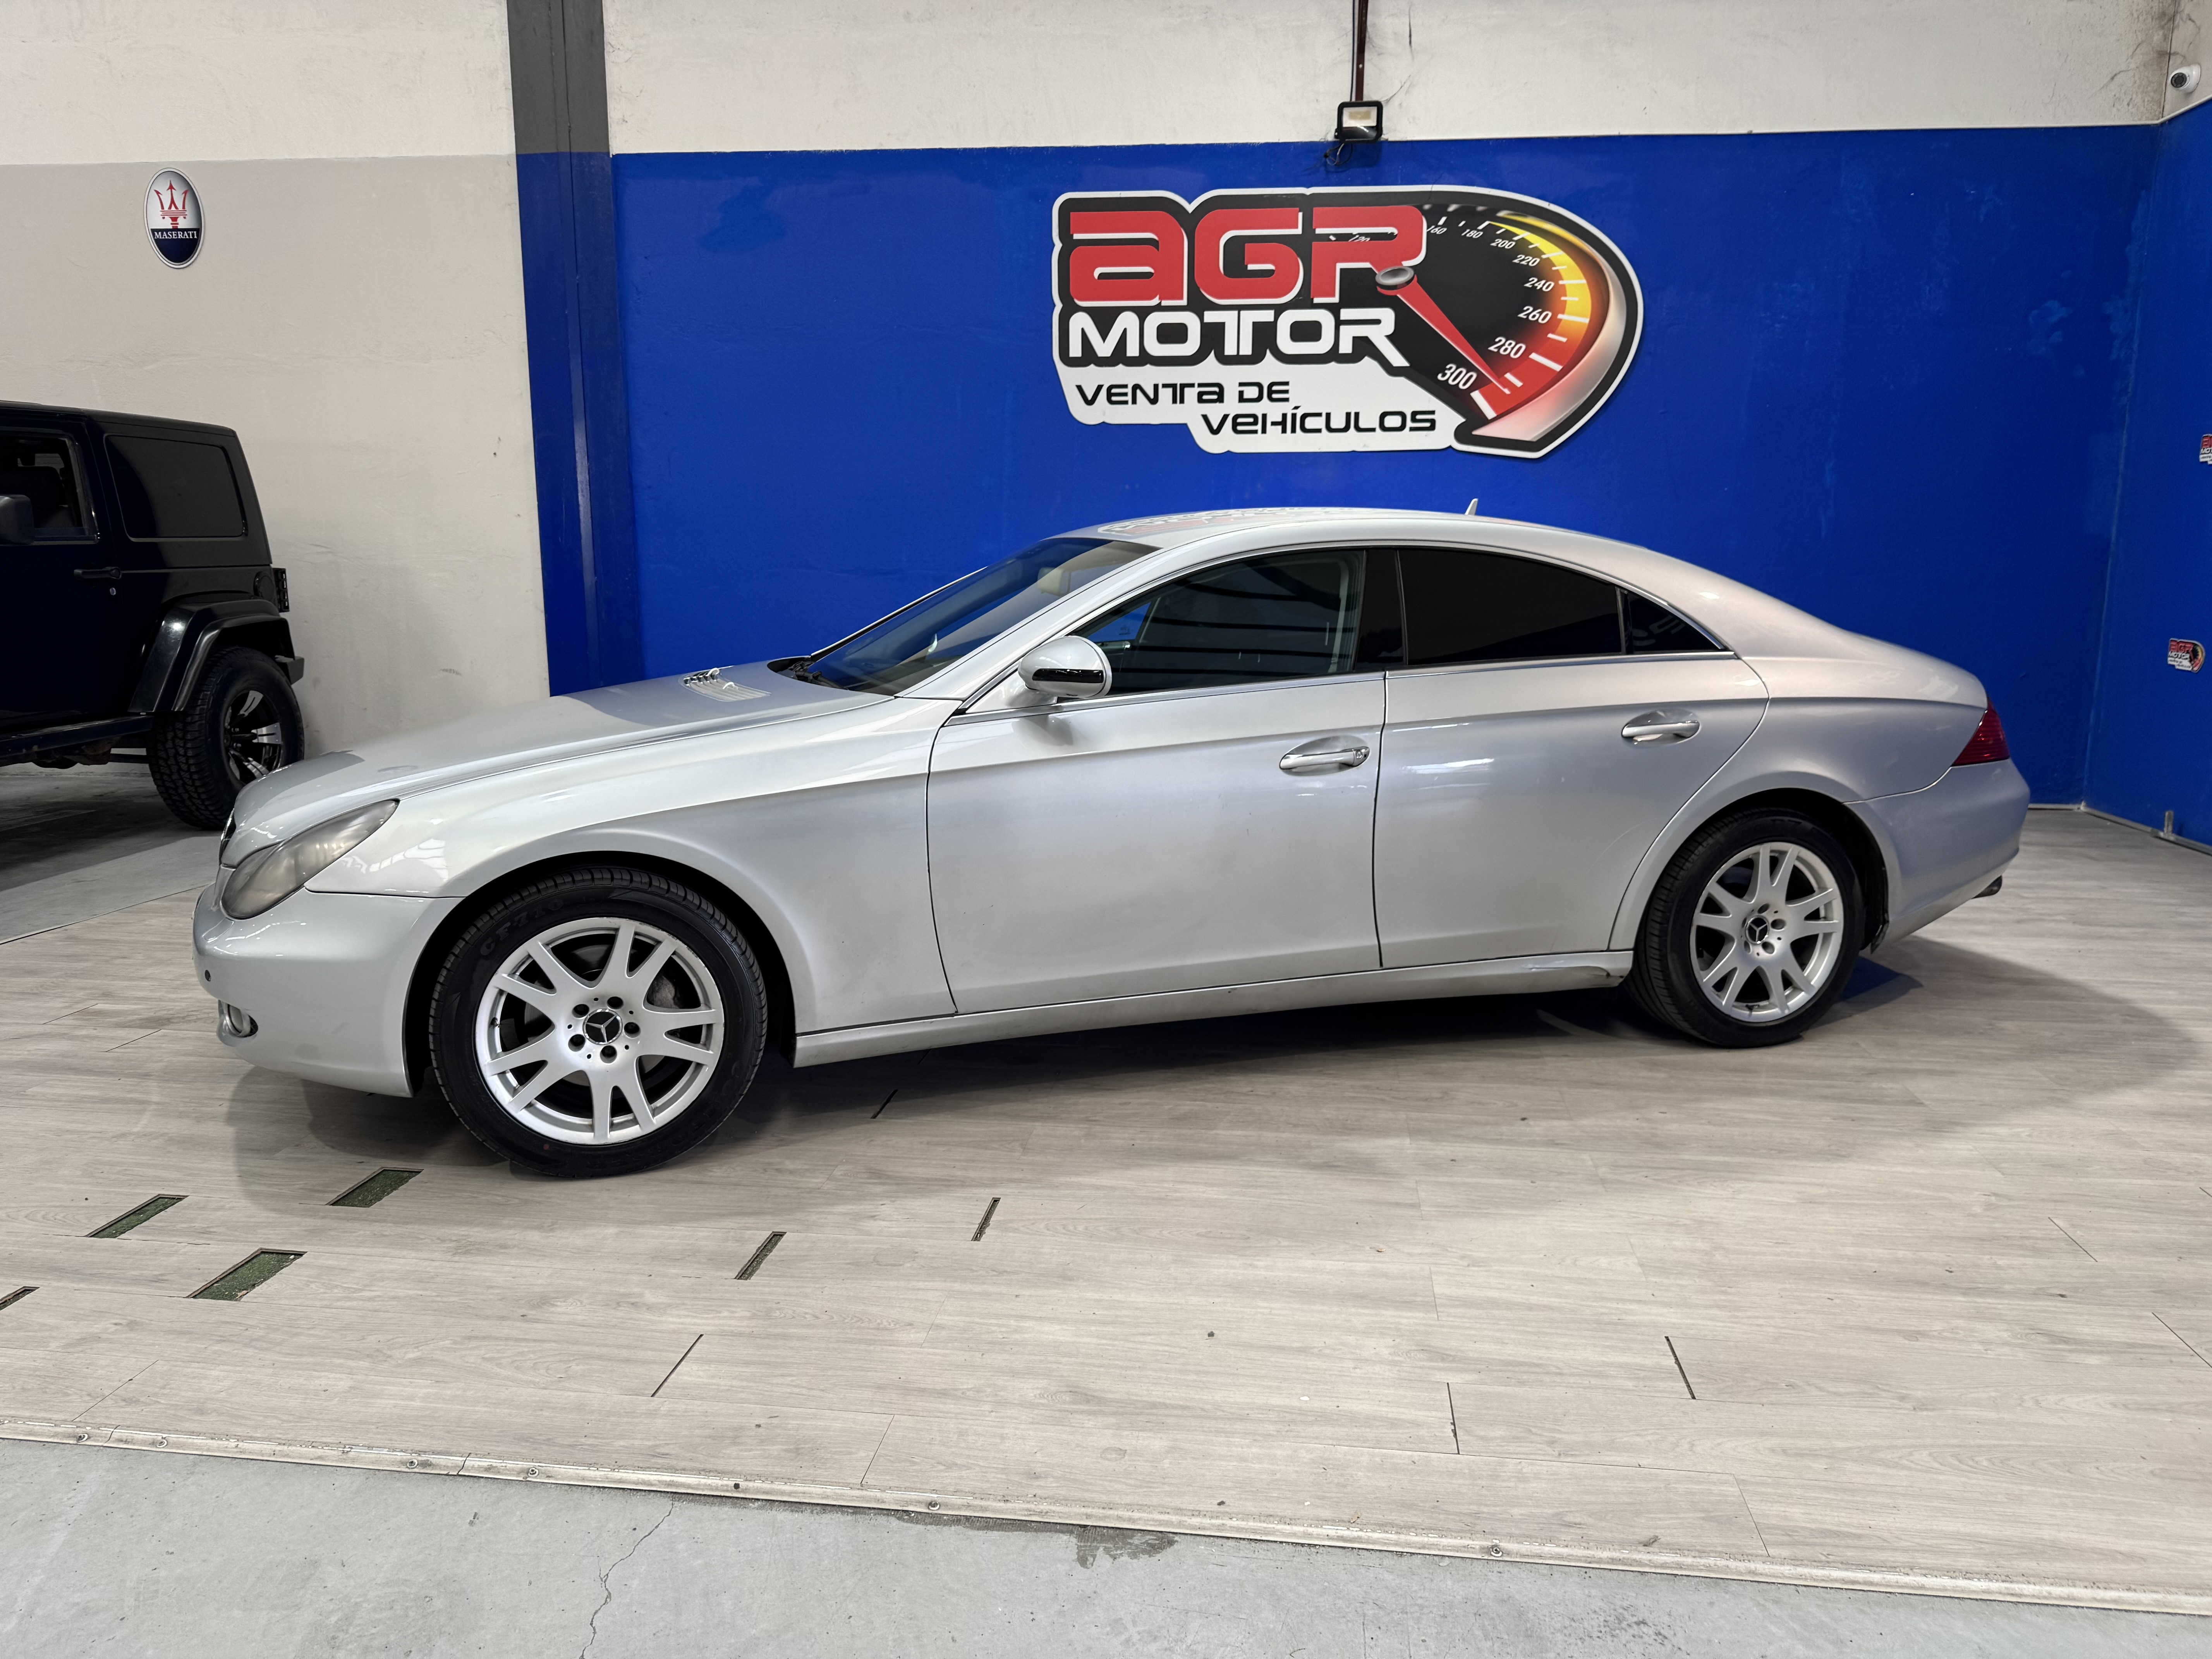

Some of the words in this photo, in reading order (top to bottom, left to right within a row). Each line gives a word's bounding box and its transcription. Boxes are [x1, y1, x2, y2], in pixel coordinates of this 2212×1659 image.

[1427, 225, 1447, 234] 160
[1461, 229, 1483, 238] 180
[1490, 239, 1516, 249] 200
[1512, 254, 1540, 266] 220
[1523, 277, 1554, 291] 240
[1518, 306, 1552, 323] 260
[1069, 308, 1410, 366] MOTOR
[1488, 337, 1526, 358] 280
[1437, 364, 1477, 389] 300
[1238, 381, 1290, 404] DE
